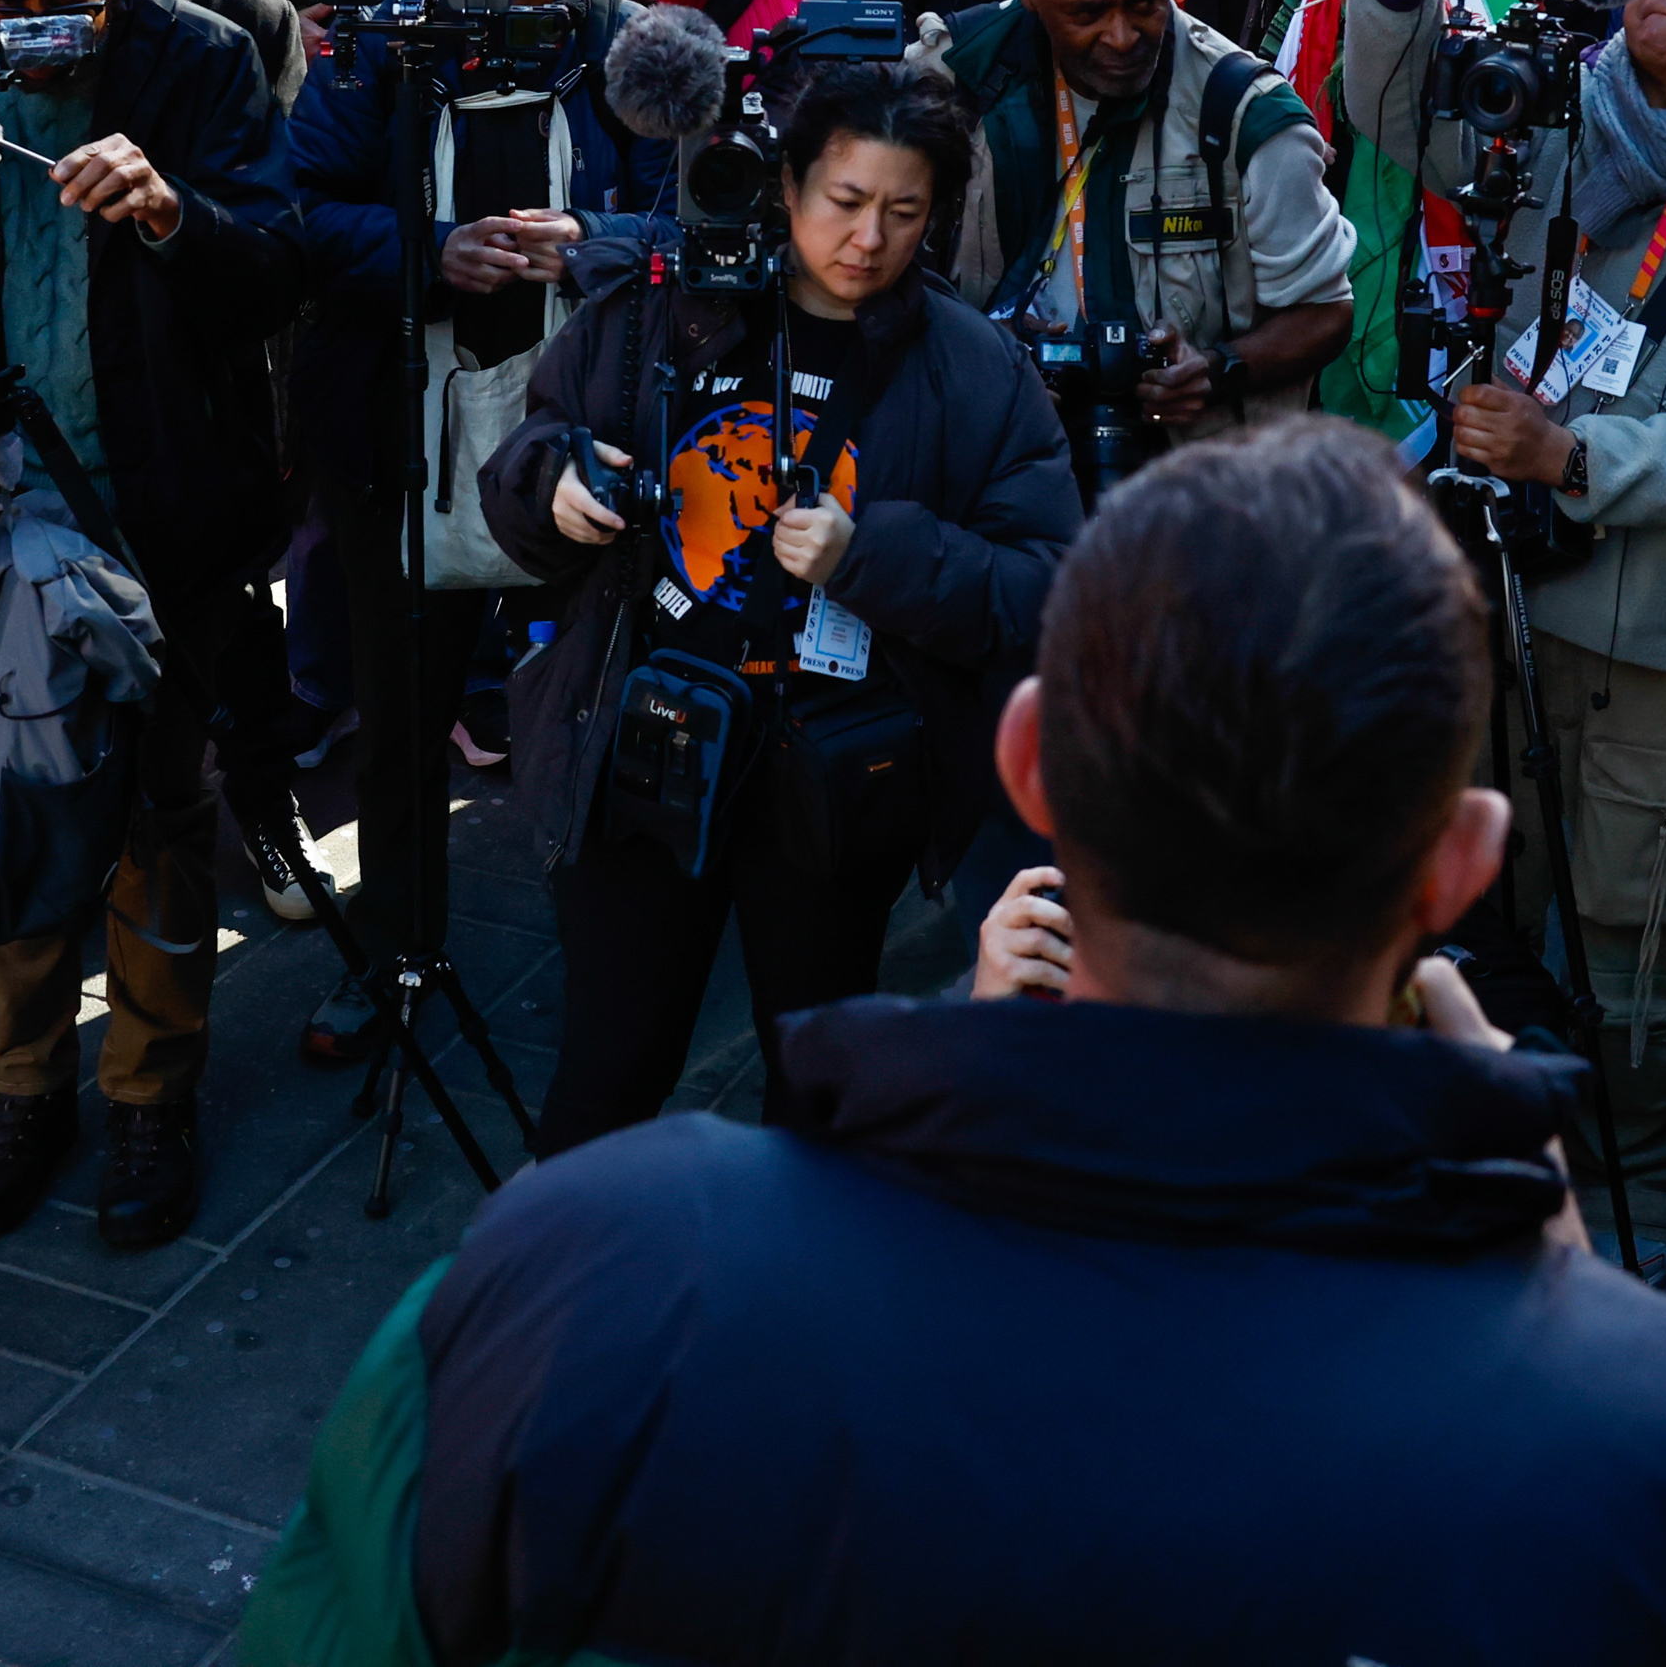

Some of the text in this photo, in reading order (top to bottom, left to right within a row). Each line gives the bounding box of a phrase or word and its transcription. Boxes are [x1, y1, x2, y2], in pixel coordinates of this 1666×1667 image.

[864, 8, 895, 18] SONY
[1059, 90, 1069, 112] MEDIA
[1063, 123, 1073, 145] MEDIA
[1073, 221, 1084, 244] MEDIA
[1550, 268, 1564, 300] EOS
[802, 655, 865, 678] PRESS PRESS
